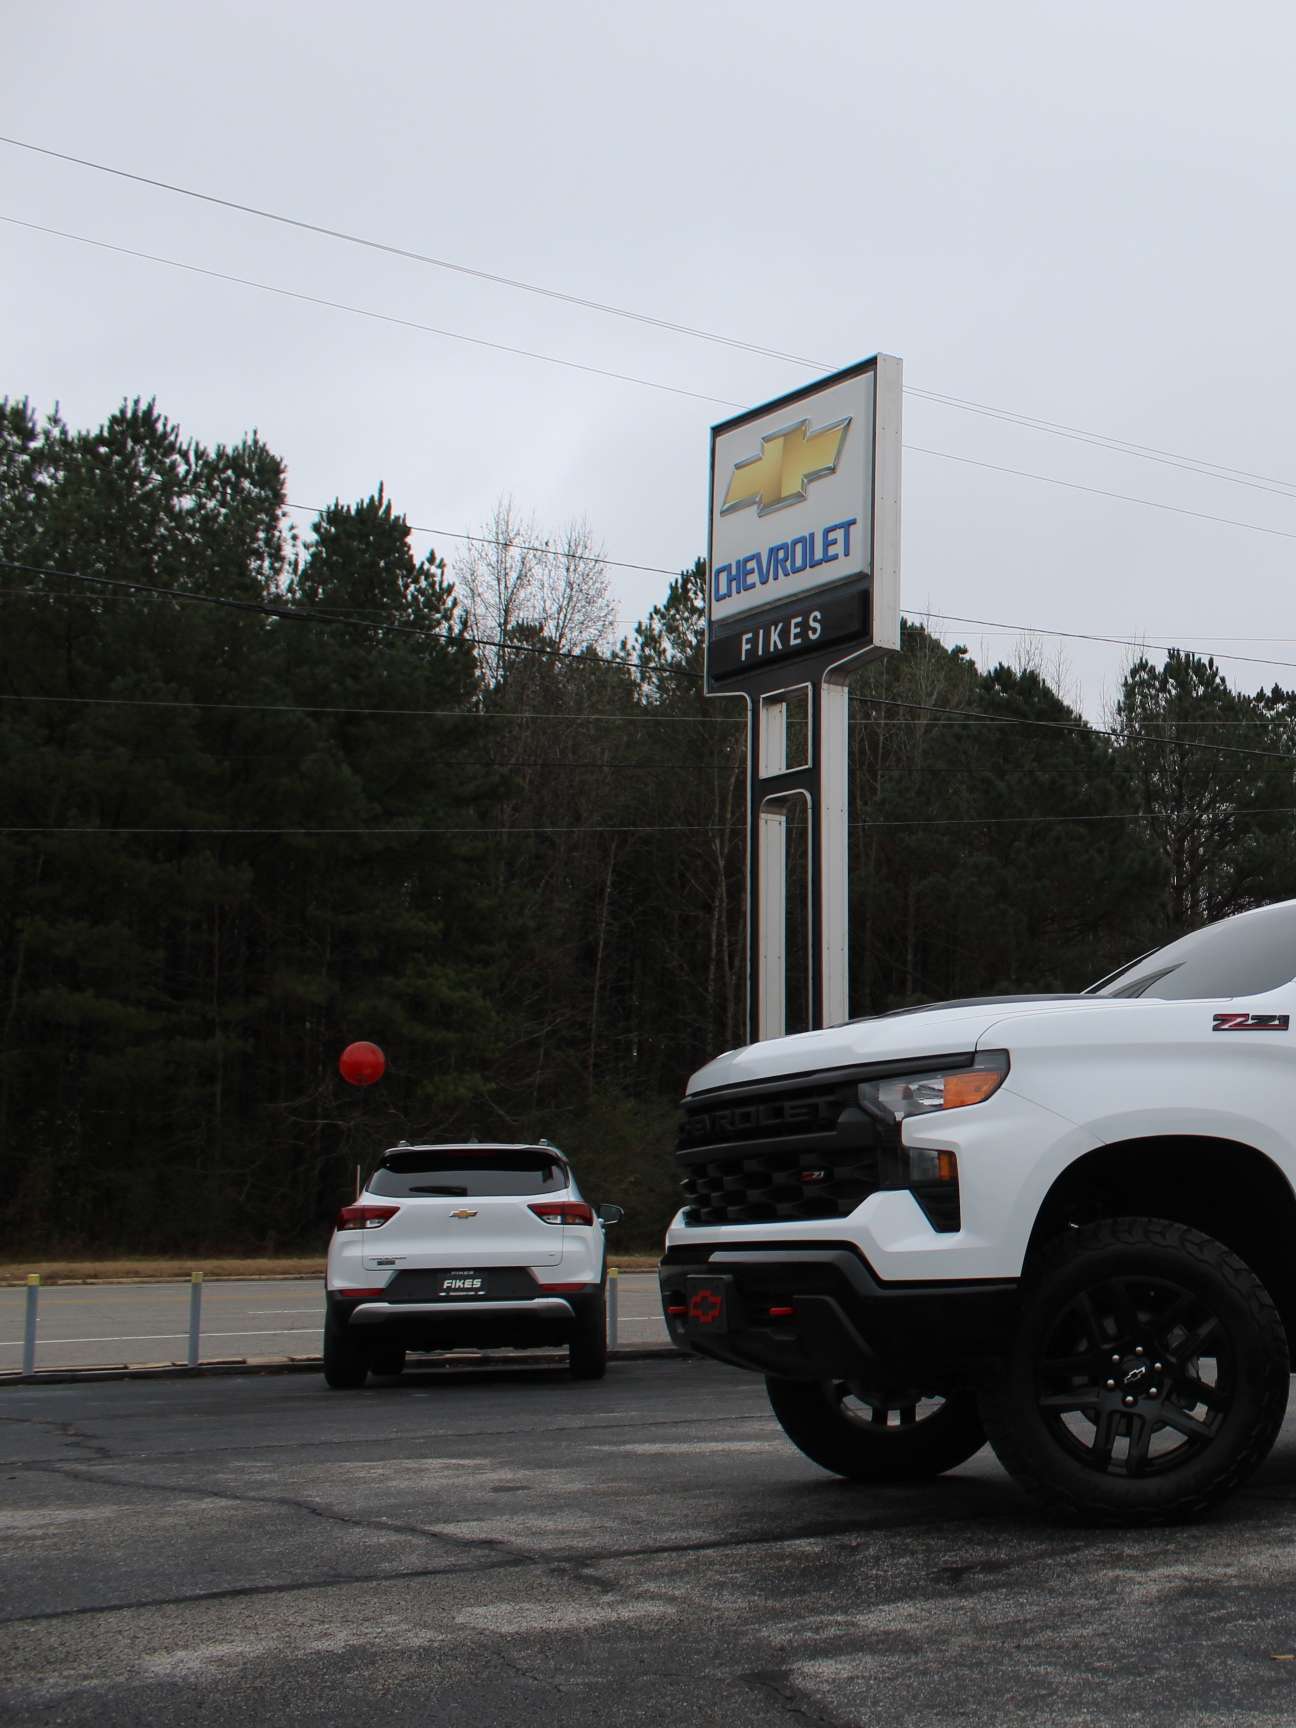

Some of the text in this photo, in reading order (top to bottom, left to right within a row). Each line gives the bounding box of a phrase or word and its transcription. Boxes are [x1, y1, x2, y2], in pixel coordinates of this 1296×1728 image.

[714, 518, 857, 602] CHEVROLET
[741, 611, 822, 661] FIKES
[1212, 1013, 1290, 1031] Z71
[800, 1170, 825, 1181] Z71
[443, 1279, 482, 1288] FIKES
